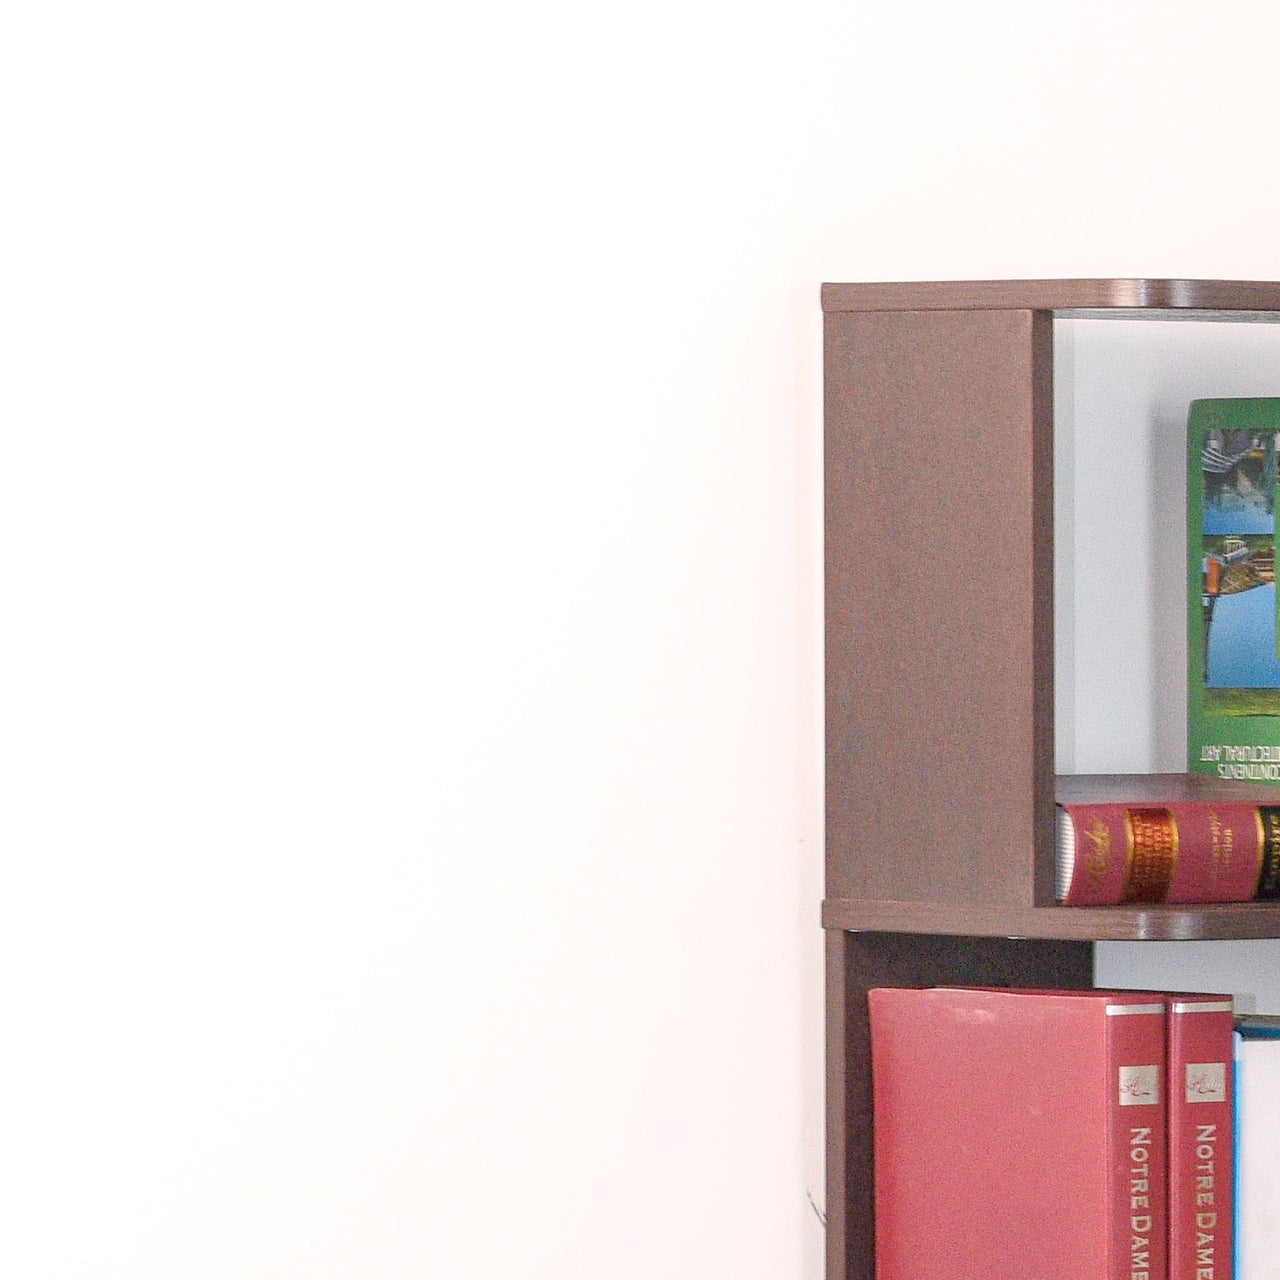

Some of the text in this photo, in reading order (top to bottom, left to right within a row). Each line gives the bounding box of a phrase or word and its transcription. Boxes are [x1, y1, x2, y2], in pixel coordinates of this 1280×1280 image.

[1200, 745, 1221, 762] ART
[1130, 1127, 1151, 1209] NOTRE
[1195, 1124, 1217, 1280] NOTRE DAME
